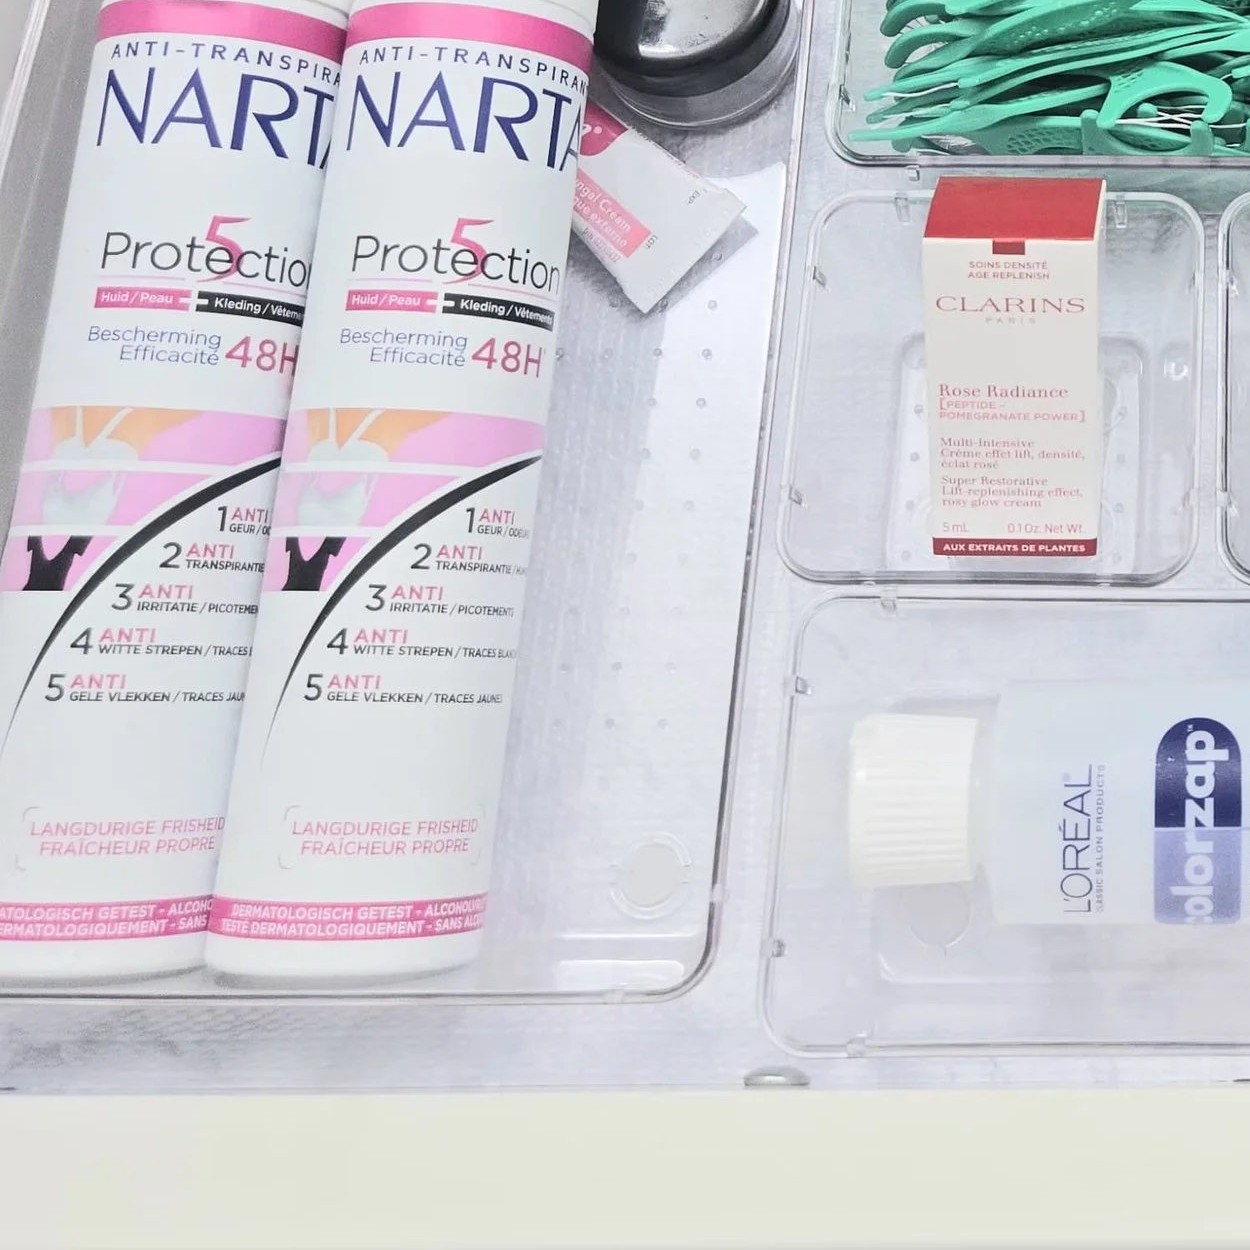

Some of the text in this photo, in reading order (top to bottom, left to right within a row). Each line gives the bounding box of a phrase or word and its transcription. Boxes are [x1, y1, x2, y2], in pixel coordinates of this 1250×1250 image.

[598, 197, 632, 233] Cream
[195, 215, 252, 283] 5
[441, 217, 495, 285] 5
[101, 232, 312, 290] Protectio
[351, 234, 560, 297] Protection
[968, 260, 1049, 270] SOINS DENSITÉ
[967, 271, 1050, 280] AGE REPLENISH
[935, 296, 1086, 314] CLARINS
[984, 317, 1037, 325] PARIS
[88, 326, 222, 350] Bescherming
[340, 327, 468, 352] Bescherming
[119, 345, 220, 367] Efficacité
[224, 335, 299, 377] 48H
[370, 346, 467, 368] Efficacité
[471, 336, 544, 379] 48H
[939, 383, 1069, 399] Rose Radiance
[939, 410, 1086, 423] POMEGRANATE POWER]
[940, 437, 1035, 448] Multi-Intensive
[984, 448, 1086, 461] effet densité,
[940, 475, 1049, 487] Super Restorative
[941, 486, 1084, 499] Lift-replenishing effect,
[941, 498, 1042, 509] rosy glow cream
[217, 505, 268, 532] 1 ANTI
[465, 507, 516, 534] 1 ANTI
[951, 522, 1065, 534] mL Net
[159, 541, 235, 569] 2 ANTI
[409, 542, 484, 570] 2 ANTI
[943, 543, 1086, 553] AUX EXTRAITS DE PLANTES
[185, 558, 265, 573] TRANSPIRANTIE
[435, 560, 511, 575] TRANSPIRANTIE
[111, 582, 194, 611] 3 ANTI
[364, 583, 445, 612] 3 ANTI
[137, 601, 197, 613] IRRITATIE
[389, 602, 449, 614] IRRITATIE
[69, 626, 157, 656] 4 ANTI
[98, 644, 249, 657] WITTE STREPEN TRACES
[326, 628, 410, 656] 4 ANTI
[353, 644, 395, 656] WITTE
[398, 644, 454, 657] STREPEN
[463, 646, 498, 659] TRACES
[44, 673, 128, 702] 5 ANTI
[69, 690, 225, 703] GELE VLEKKEN TRACES
[303, 673, 383, 702] 5 ANTI
[326, 690, 475, 704] GELE VLEKKEN TRACES
[30, 816, 227, 837] LANGDURIGE FRISHEID
[291, 817, 480, 837] LANGDURIGE FRISHEID
[1096, 763, 1107, 875] SALON PRODUCTS
[38, 836, 216, 856] FRAÎCHEUR PROPRE
[300, 836, 470, 856] FRAÎCHEUR PROPRE
[1058, 763, 1093, 913] L'ORÉAL
[98, 904, 158, 919] GETEST
[231, 904, 415, 920] DERMATOLOGISCH GETEST
[251, 918, 463, 936] DERMATOLOGIQUEMENT SANS
